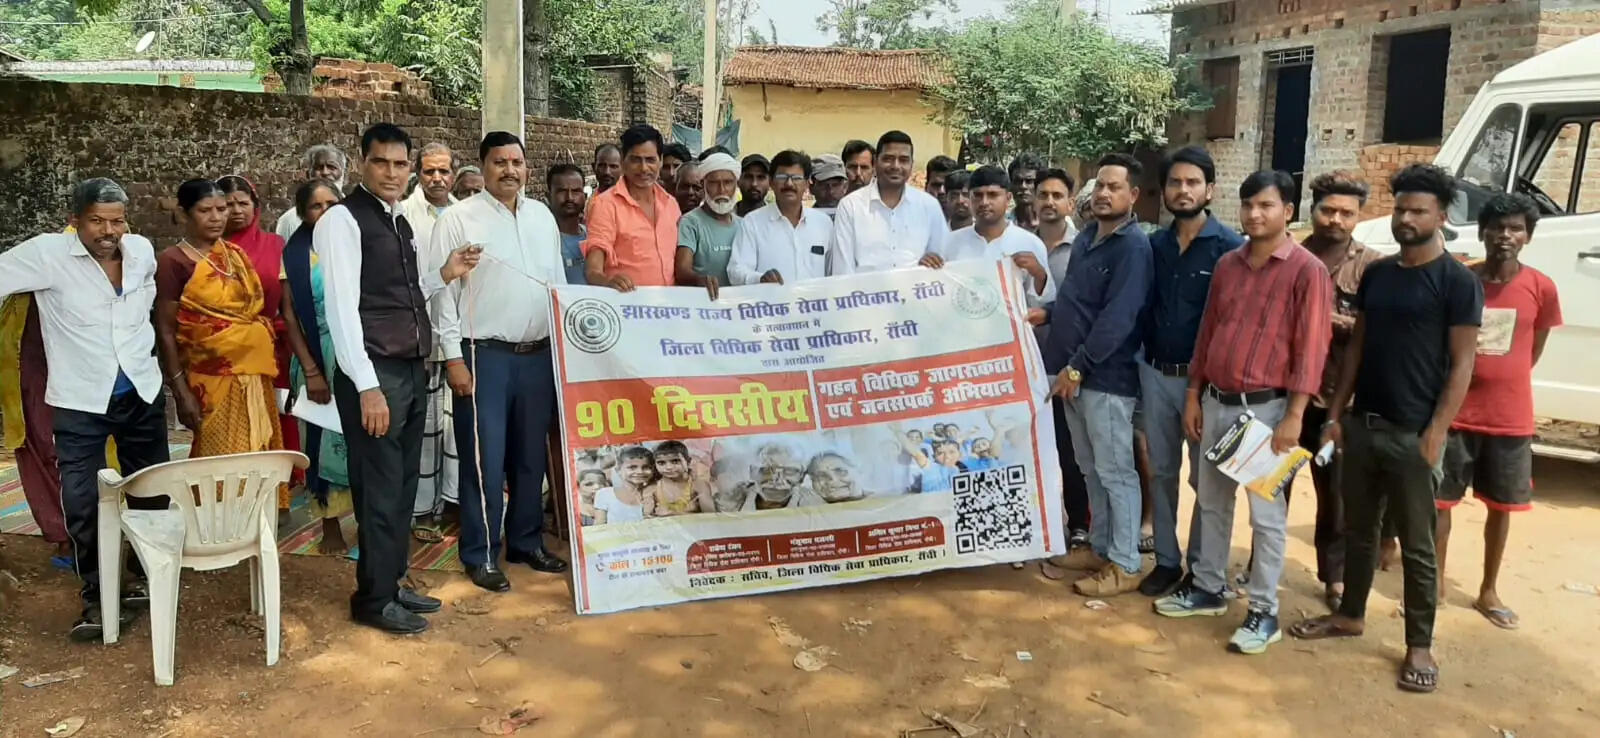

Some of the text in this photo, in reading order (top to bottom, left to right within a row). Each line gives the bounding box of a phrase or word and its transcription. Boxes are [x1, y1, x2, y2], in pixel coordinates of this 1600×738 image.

[620, 304, 690, 321] झारखण्ड
[696, 307, 733, 321] राज्य
[738, 301, 790, 321] विधिक
[796, 297, 828, 315] सेवा
[834, 290, 906, 311] प्राधिकार,
[660, 339, 705, 356] जिला
[710, 339, 763, 355] विधिक
[768, 335, 801, 353] सेवा
[806, 329, 878, 350] प्राधिकार,
[817, 379, 858, 397] गहन
[863, 371, 921, 393] विधिक
[575, 382, 810, 438] 90 दिवसीय
[825, 397, 853, 419] एवं
[941, 379, 1016, 404] अभियान
[778, 567, 804, 578] जिला
[808, 564, 841, 575] विधिक
